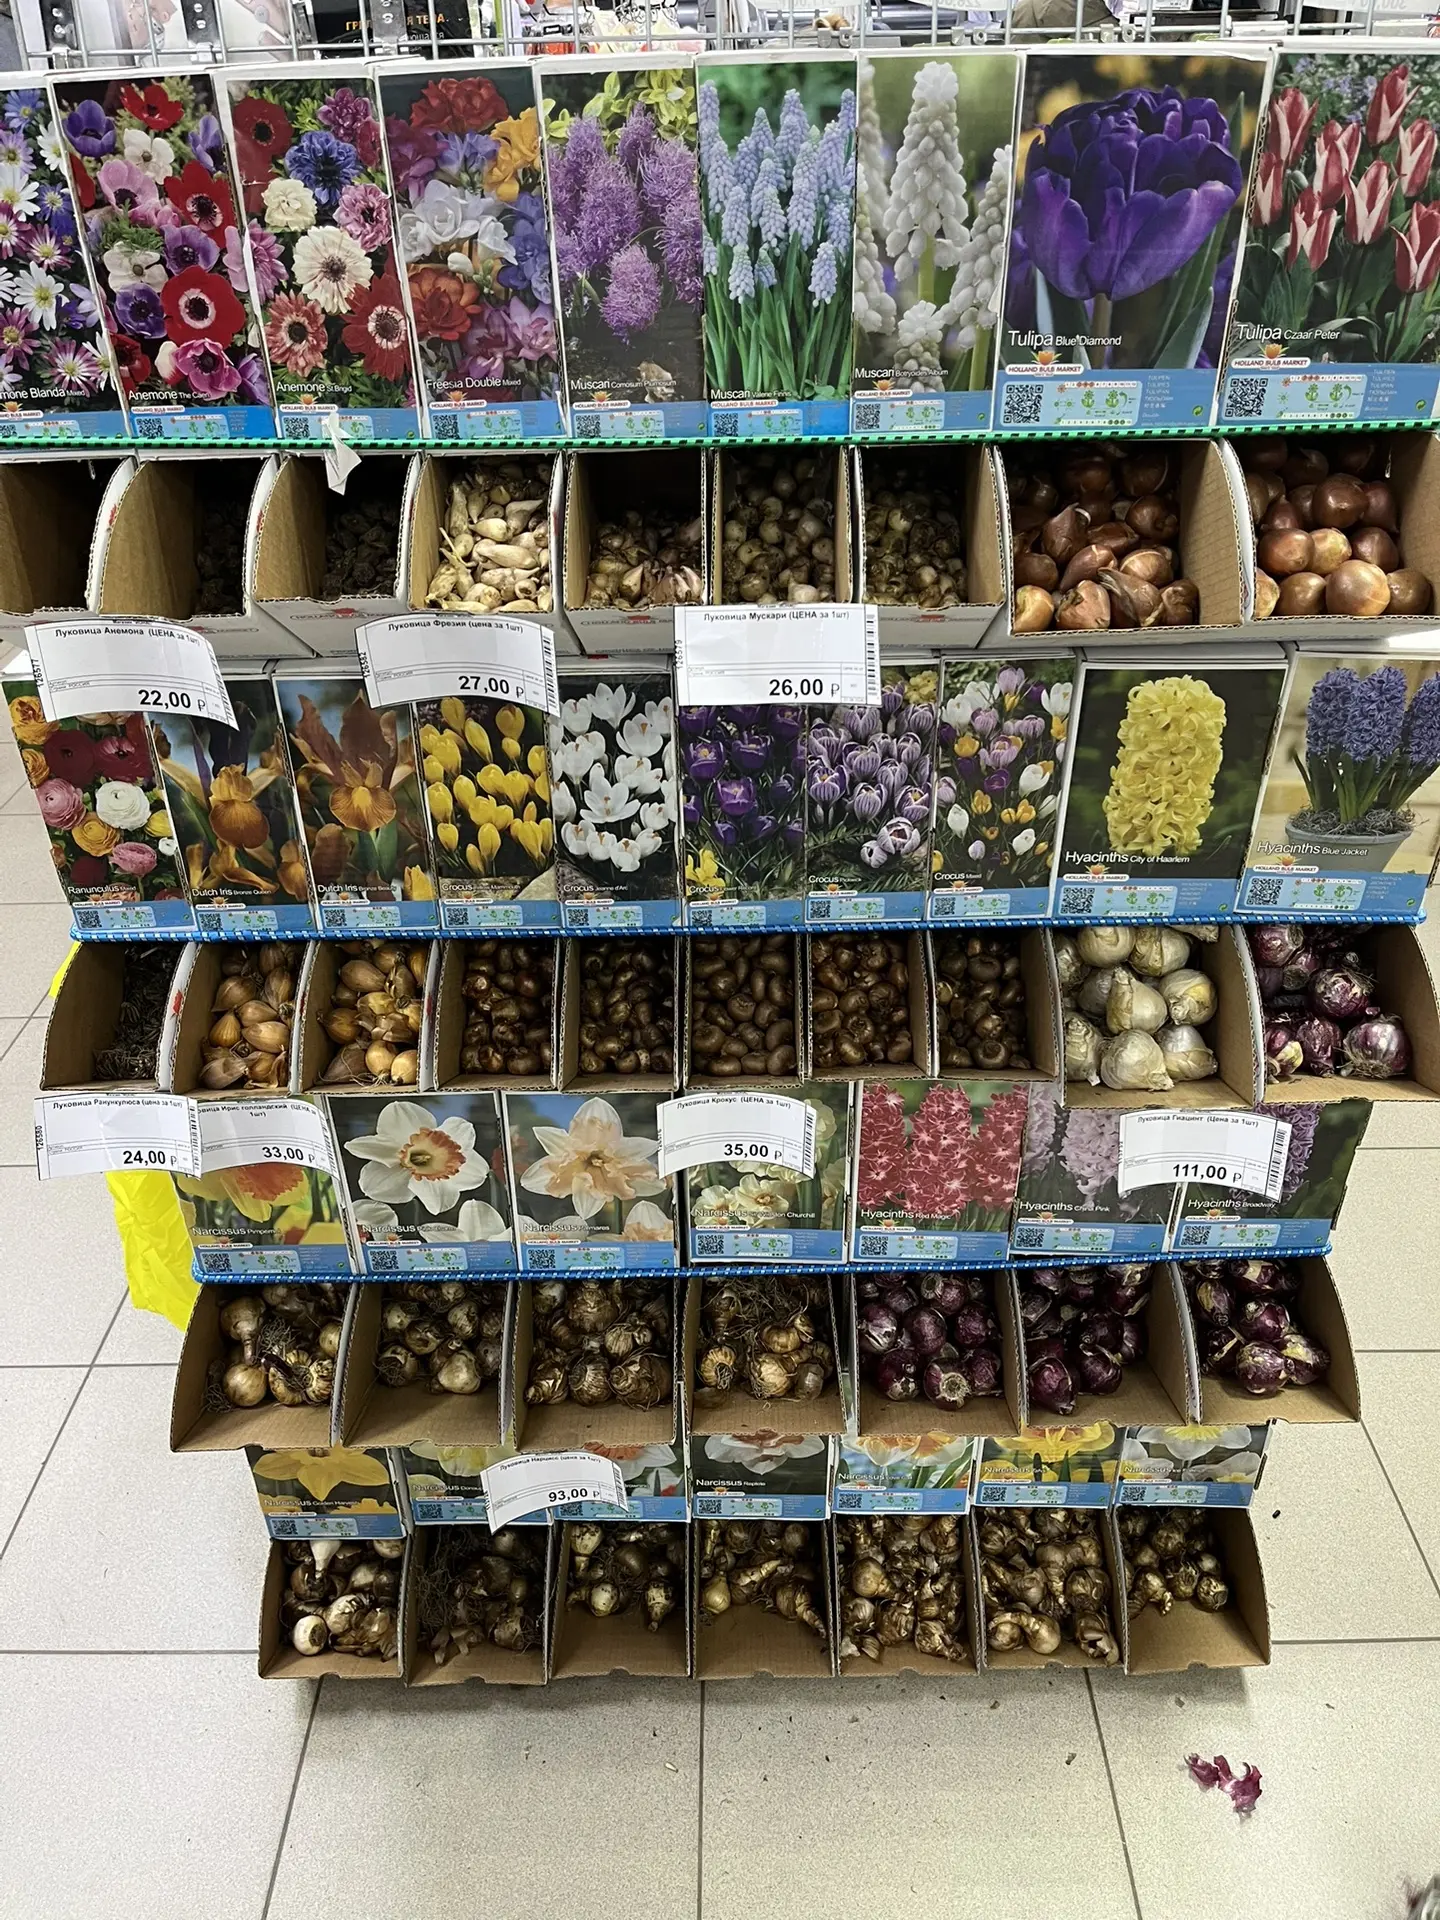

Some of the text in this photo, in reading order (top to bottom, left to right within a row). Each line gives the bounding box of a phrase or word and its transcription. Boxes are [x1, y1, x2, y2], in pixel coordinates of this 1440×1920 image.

[417, 13, 445, 25] ТЕА
[1237, 324, 1340, 341] Tulipa Czaar Peter
[1008, 331, 1121, 347] Tulipa Blue Diamond
[276, 381, 325, 392] Anemone
[426, 378, 463, 390] Freesia
[465, 377, 501, 388] Double
[0, 390, 29, 400] mone
[31, 387, 66, 398] Blanda
[128, 390, 177, 401] Anemone
[703, 612, 746, 621] Луковица
[749, 611, 786, 621] Мускари
[788, 611, 817, 620] (ЦЕНА
[831, 611, 850, 620] 1шт)
[55, 626, 102, 638] Луковица
[104, 627, 144, 636] Анемона
[148, 629, 175, 638] (ЦЕНА
[388, 620, 431, 631] Луковица
[433, 619, 466, 628] Фрезия
[468, 620, 492, 629] (цена
[505, 623, 523, 634] 1шт)
[458, 675, 510, 694] 27,00
[769, 678, 823, 699] 26,00
[138, 689, 192, 710] 22,00
[1256, 842, 1368, 856] Hyacinths Blue Jacket
[1065, 851, 1189, 865] Hyacinths City of Haarlem
[808, 875, 839, 883] Crocus
[934, 873, 965, 881] Crocus
[68, 885, 119, 895] Ranunculus
[192, 888, 218, 898] Dutch
[219, 888, 233, 897] Iris
[318, 885, 344, 893] Dutch
[345, 884, 358, 893] Iris
[442, 883, 473, 892] Crocus
[563, 884, 594, 892] Crocus
[690, 885, 719, 893] Crocus
[53, 1099, 92, 1110] Луковица
[142, 1099, 160, 1107] (цена
[677, 1097, 710, 1109] Луковица
[711, 1096, 737, 1104] Крокус
[740, 1096, 765, 1105] (ЦЕНА
[775, 1099, 791, 1110] 1шт)
[1137, 1116, 1170, 1124] Луковица
[1172, 1114, 1203, 1122] Гиацинт
[1241, 1118, 1258, 1129] 1шт)
[261, 1146, 304, 1161] 33,00
[724, 1143, 769, 1158] 35,00
[122, 1150, 166, 1166] 24,00
[1172, 1164, 1227, 1181] 111,00
[1020, 1202, 1073, 1212] Hyacinths
[1188, 1199, 1241, 1209] Hyacinths
[694, 1208, 747, 1218] Narcissus
[860, 1210, 914, 1220] Hyacinths
[192, 1227, 247, 1236] Narcissus
[362, 1224, 415, 1233] Narcissus
[523, 1223, 577, 1232] Narcissus
[696, 1479, 742, 1487] Narcissus
[549, 1488, 588, 1503] 93,00
[264, 1499, 311, 1507] Narcissus
